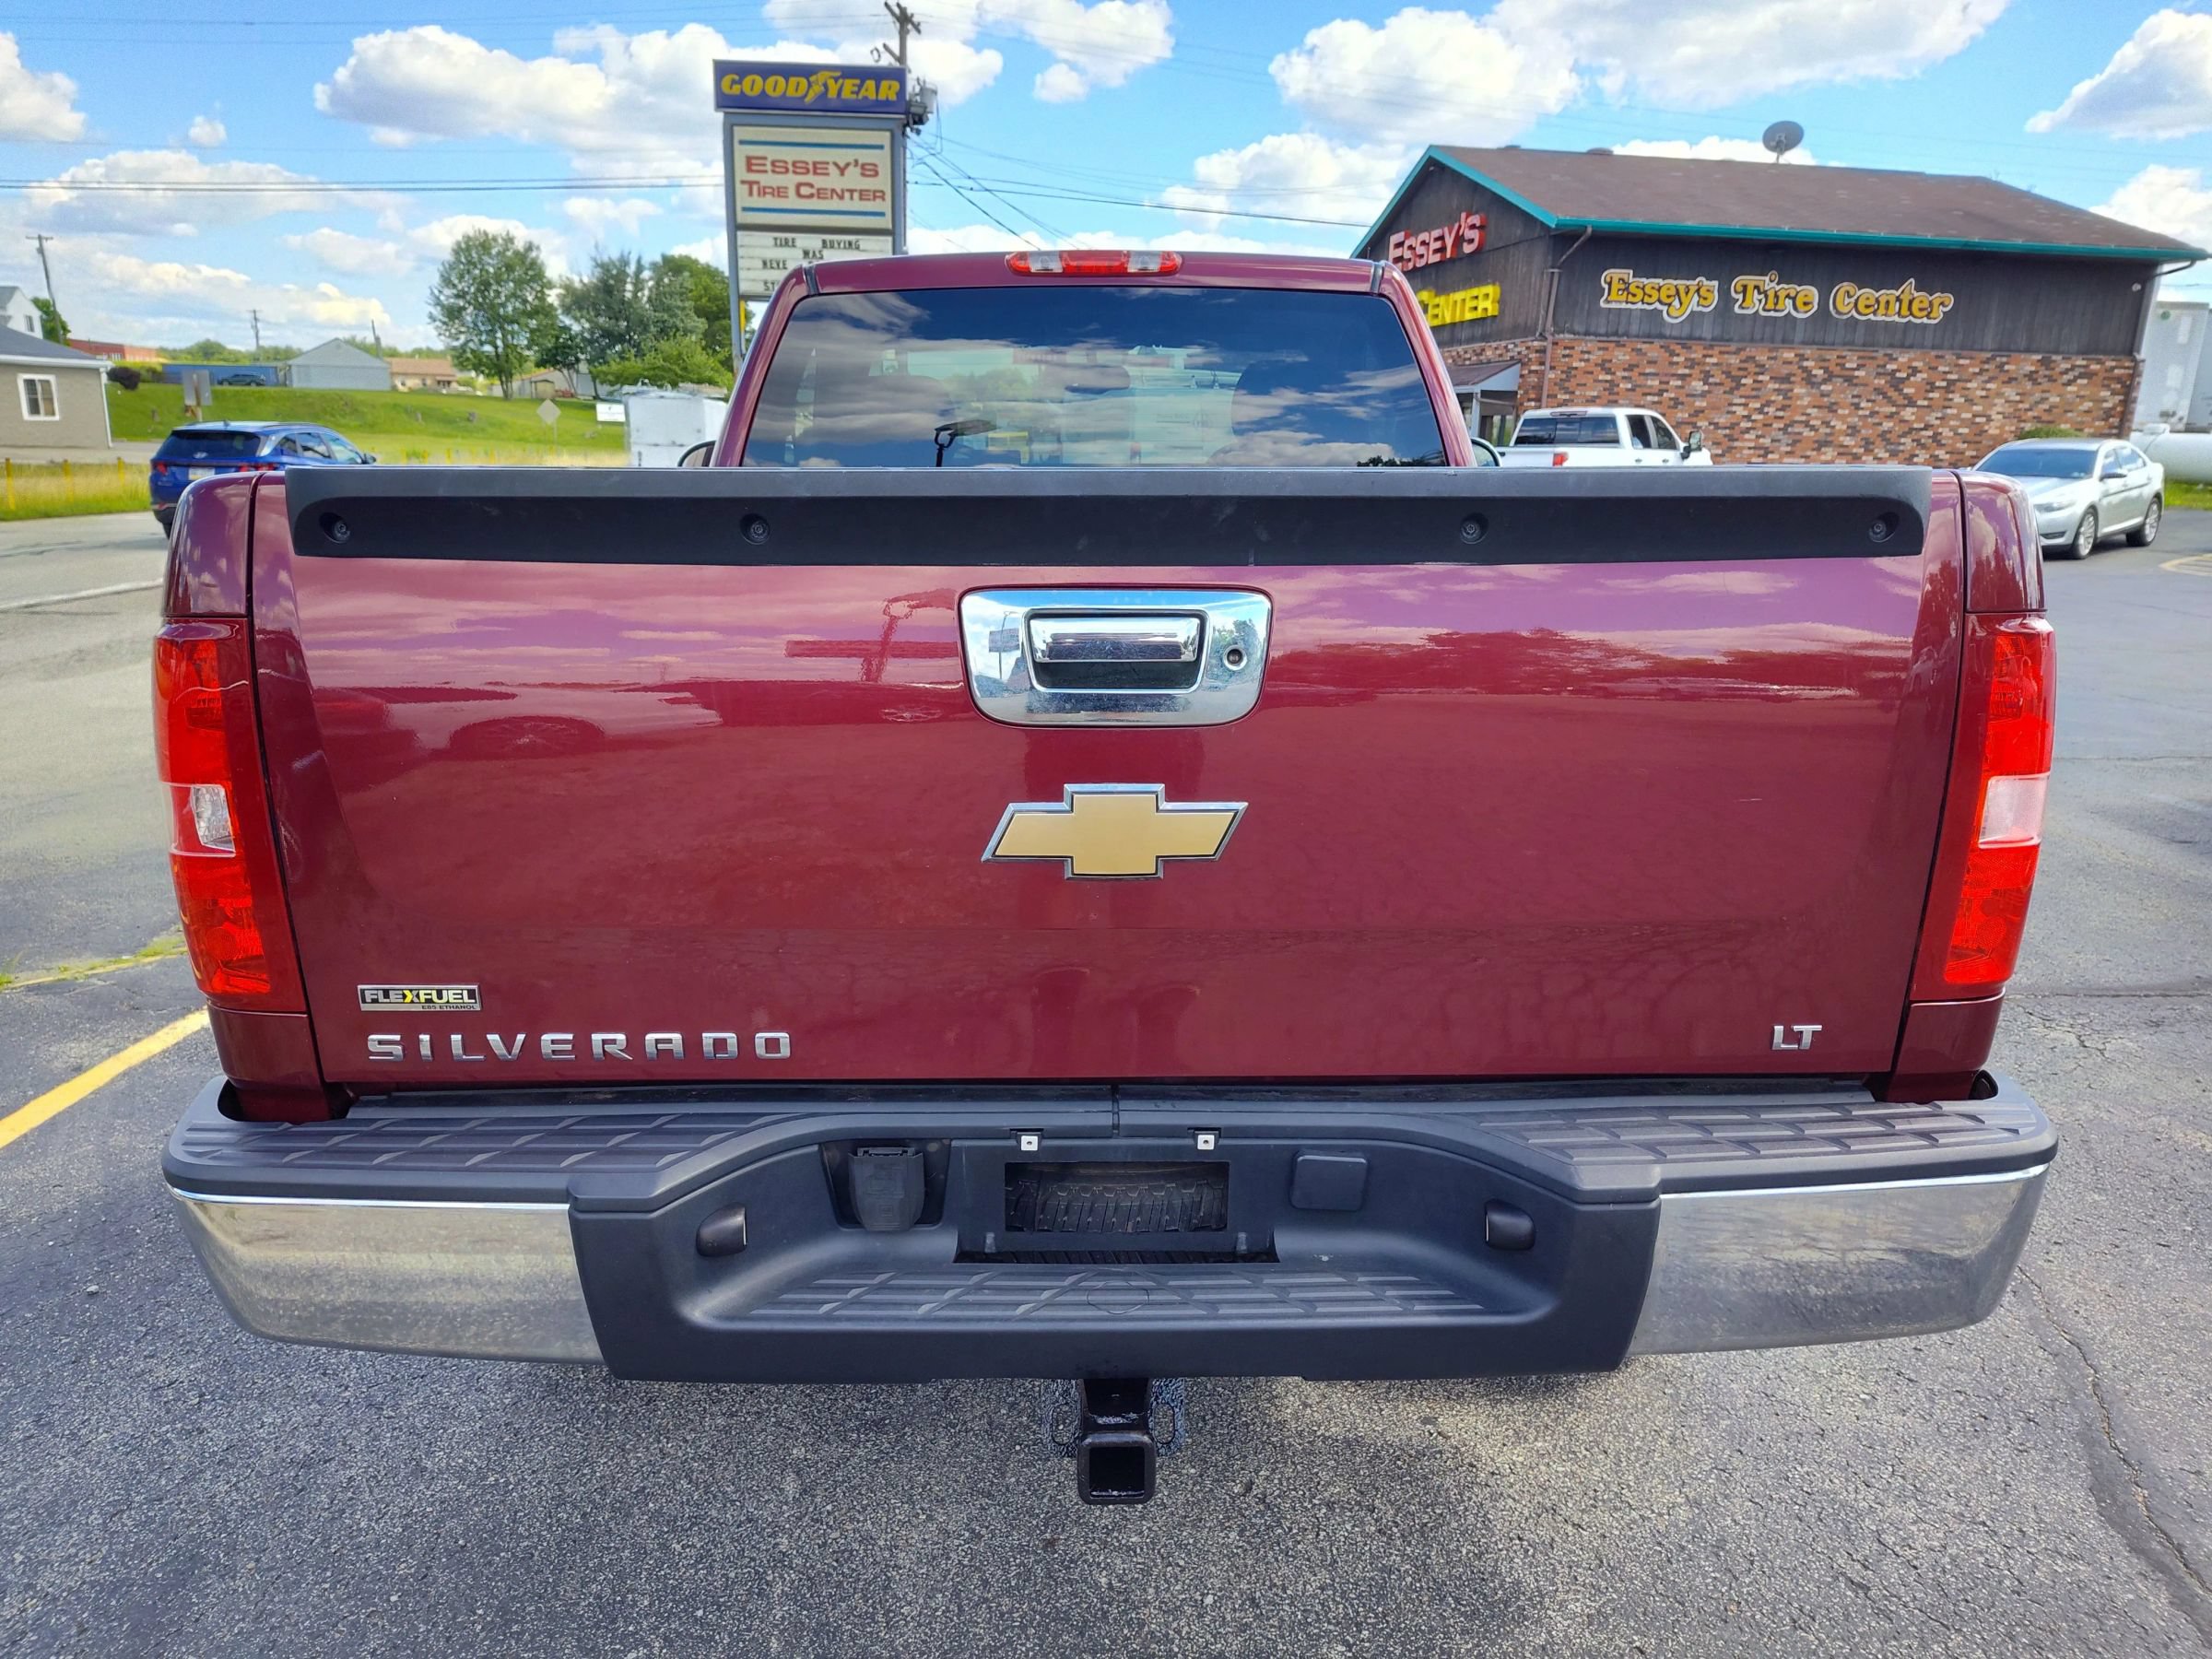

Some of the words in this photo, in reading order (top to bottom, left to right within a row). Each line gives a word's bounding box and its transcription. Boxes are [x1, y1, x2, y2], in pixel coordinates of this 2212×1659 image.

[720, 70, 900, 104] GOODYEAR
[745, 155, 879, 178] ESSEY'S
[740, 180, 789, 199] TIRE
[794, 182, 886, 202] CENTER
[772, 237, 797, 248] TIRE
[821, 239, 861, 250] BUYING
[1388, 211, 1488, 272] ESSEY'S
[803, 250, 824, 259] WAS
[1603, 270, 1716, 319] Essey's
[1733, 270, 1817, 313] Tire
[1833, 280, 1954, 321] Center
[364, 989, 477, 1004] FLEXFUEL
[367, 1032, 792, 1062] SILVERADO
[1771, 1024, 1823, 1051] LT
